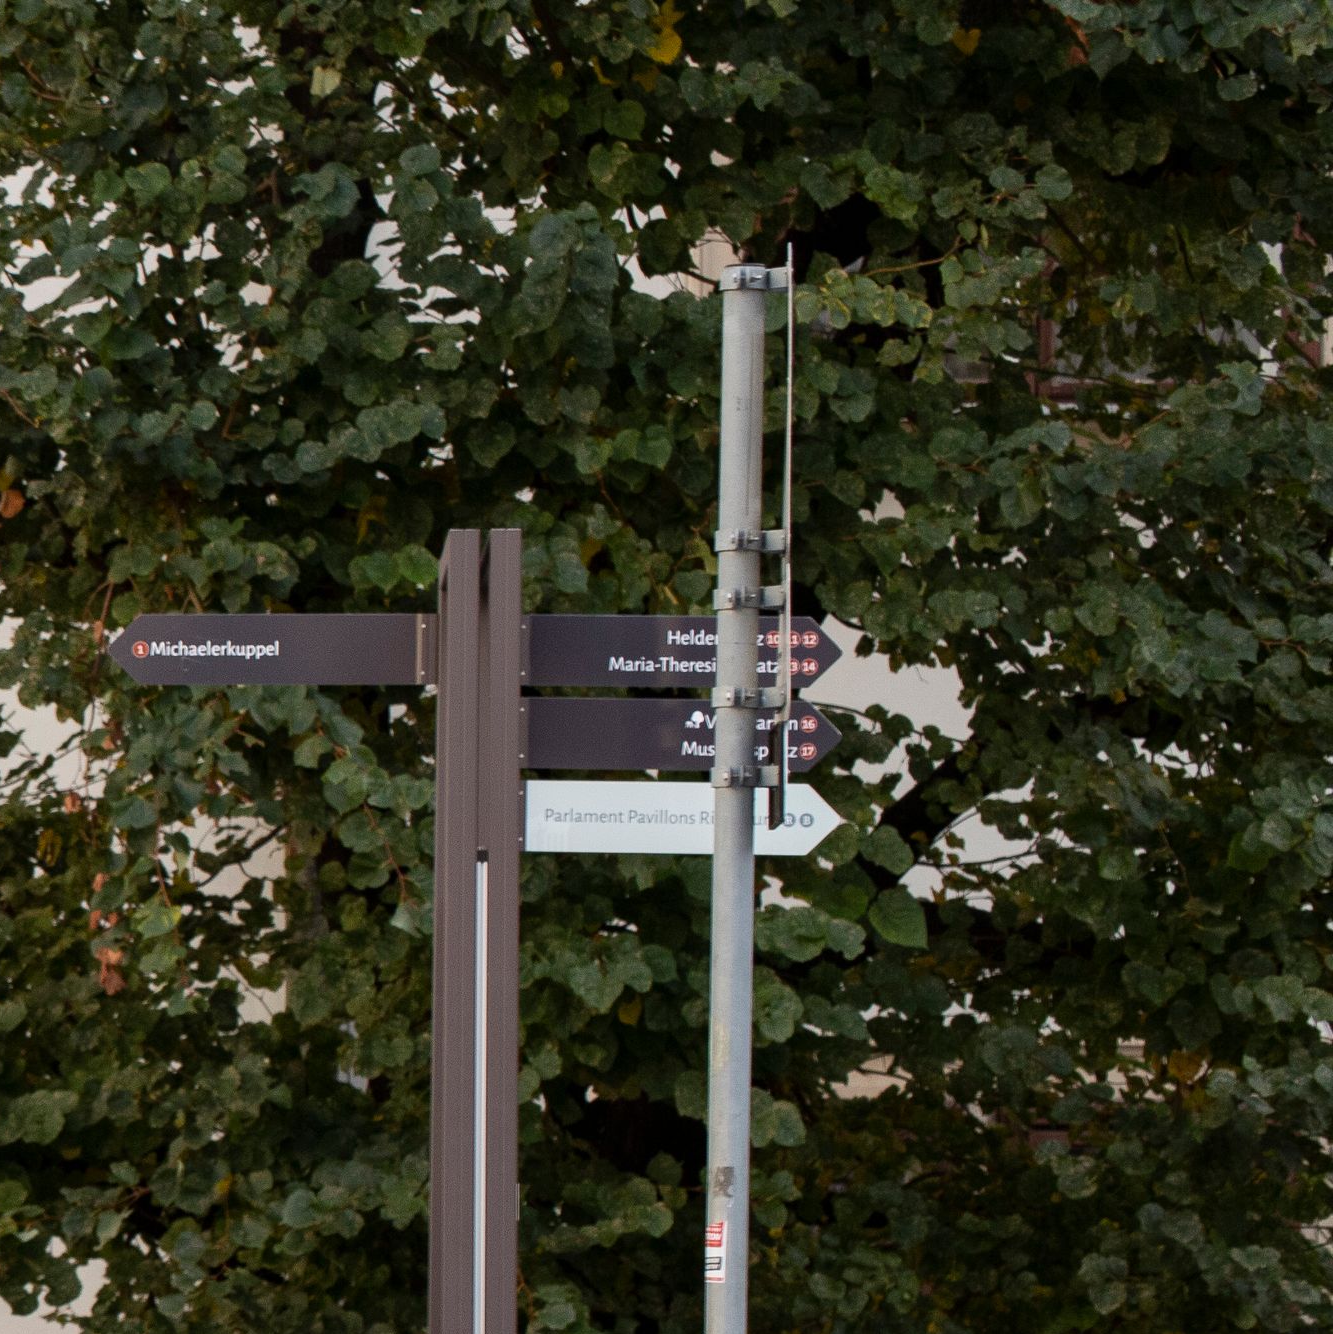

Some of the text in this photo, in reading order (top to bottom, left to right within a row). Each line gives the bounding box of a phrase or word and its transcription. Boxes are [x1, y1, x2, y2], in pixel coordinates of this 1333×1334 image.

[803, 633, 817, 646] 12
[150, 640, 280, 660] Michaelerkuppel
[608, 656, 780, 673] Maria-Theresiatz
[802, 660, 816, 673] 14
[801, 718, 815, 730] 16
[801, 745, 815, 758] 17
[545, 808, 624, 823] Parlament
[628, 810, 696, 825] Pavillons
